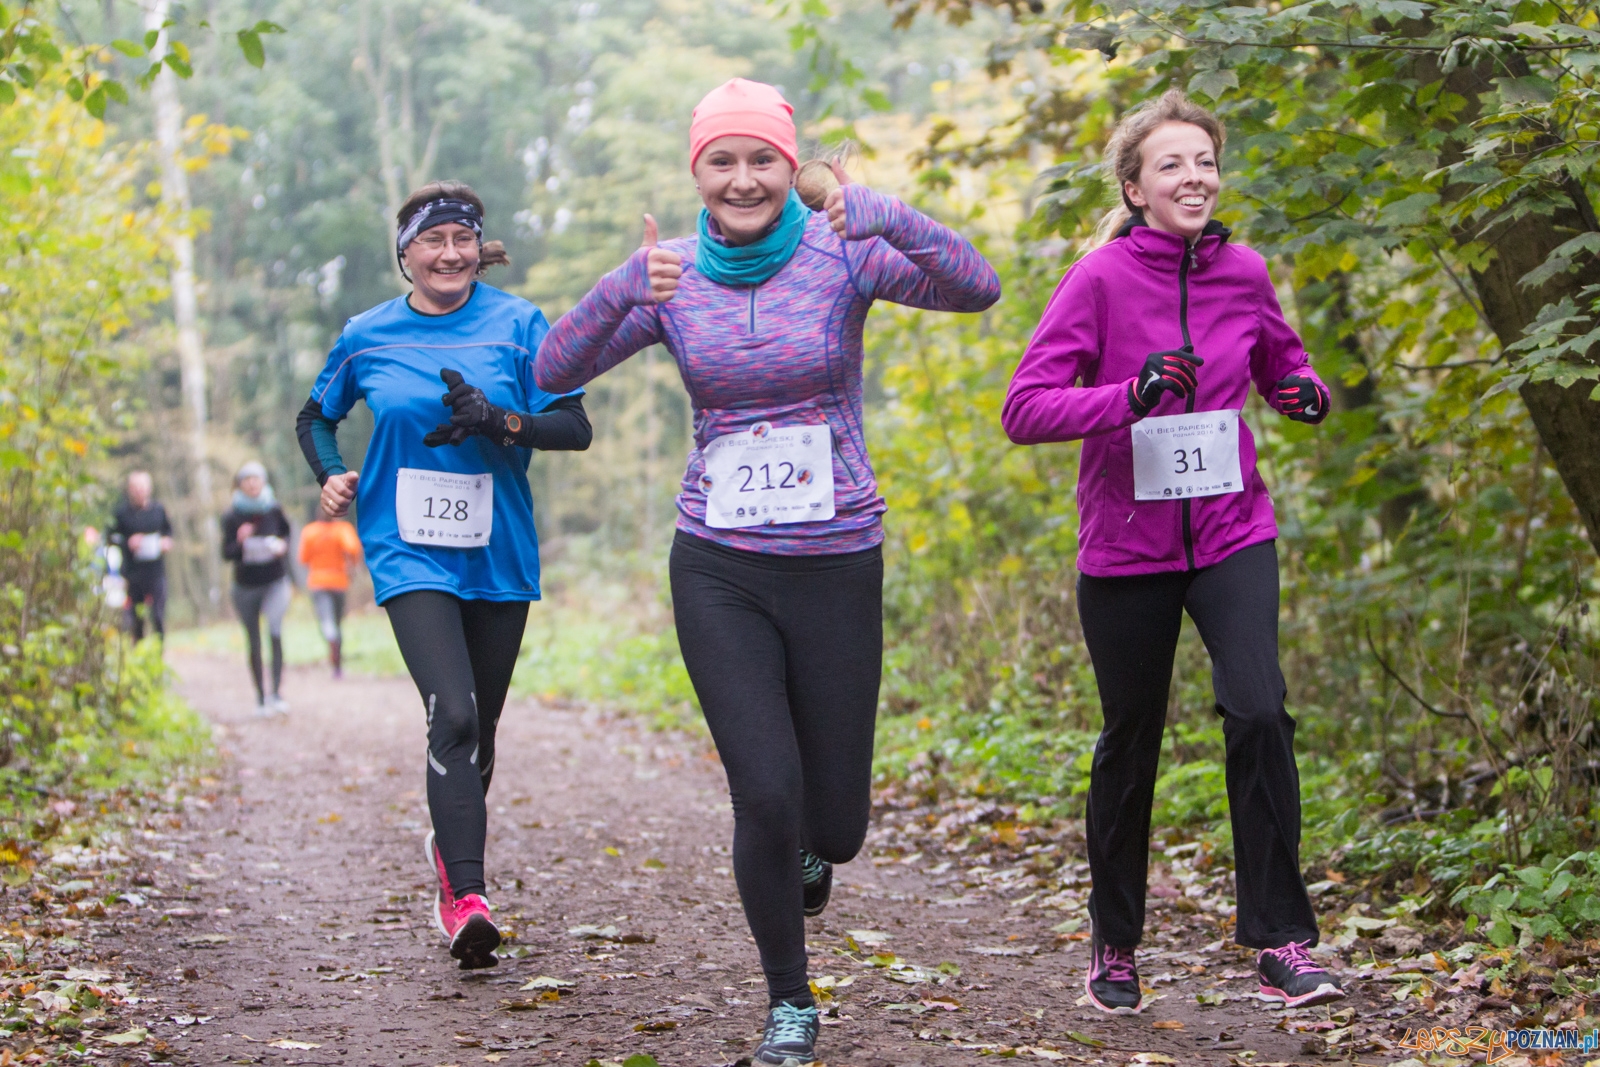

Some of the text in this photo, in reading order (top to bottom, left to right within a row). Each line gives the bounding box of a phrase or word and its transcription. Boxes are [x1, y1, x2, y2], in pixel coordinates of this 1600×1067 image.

[1173, 447, 1207, 474] 31
[737, 461, 796, 492] 212
[423, 496, 469, 522] 128
